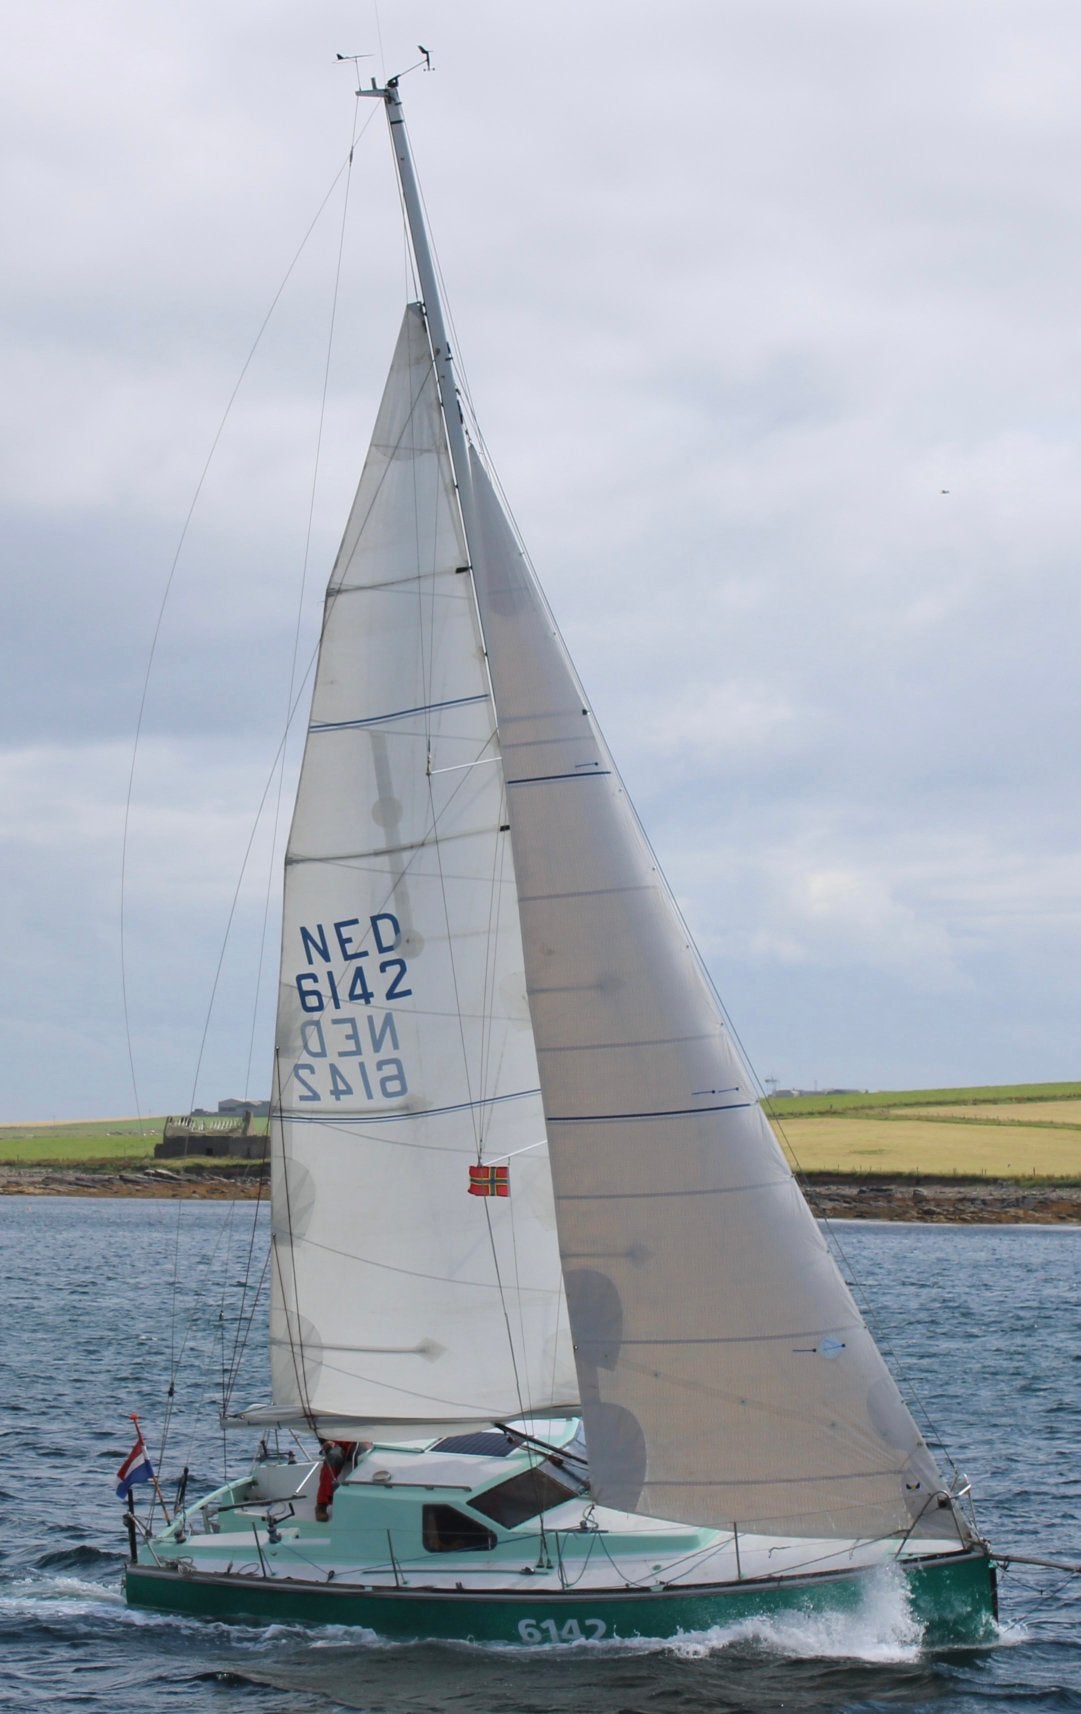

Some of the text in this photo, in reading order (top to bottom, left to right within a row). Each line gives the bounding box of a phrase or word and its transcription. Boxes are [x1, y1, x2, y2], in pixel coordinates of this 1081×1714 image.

[300, 913, 401, 965] NED
[295, 958, 412, 1013] 6142
[517, 1618, 607, 1645] 6142
